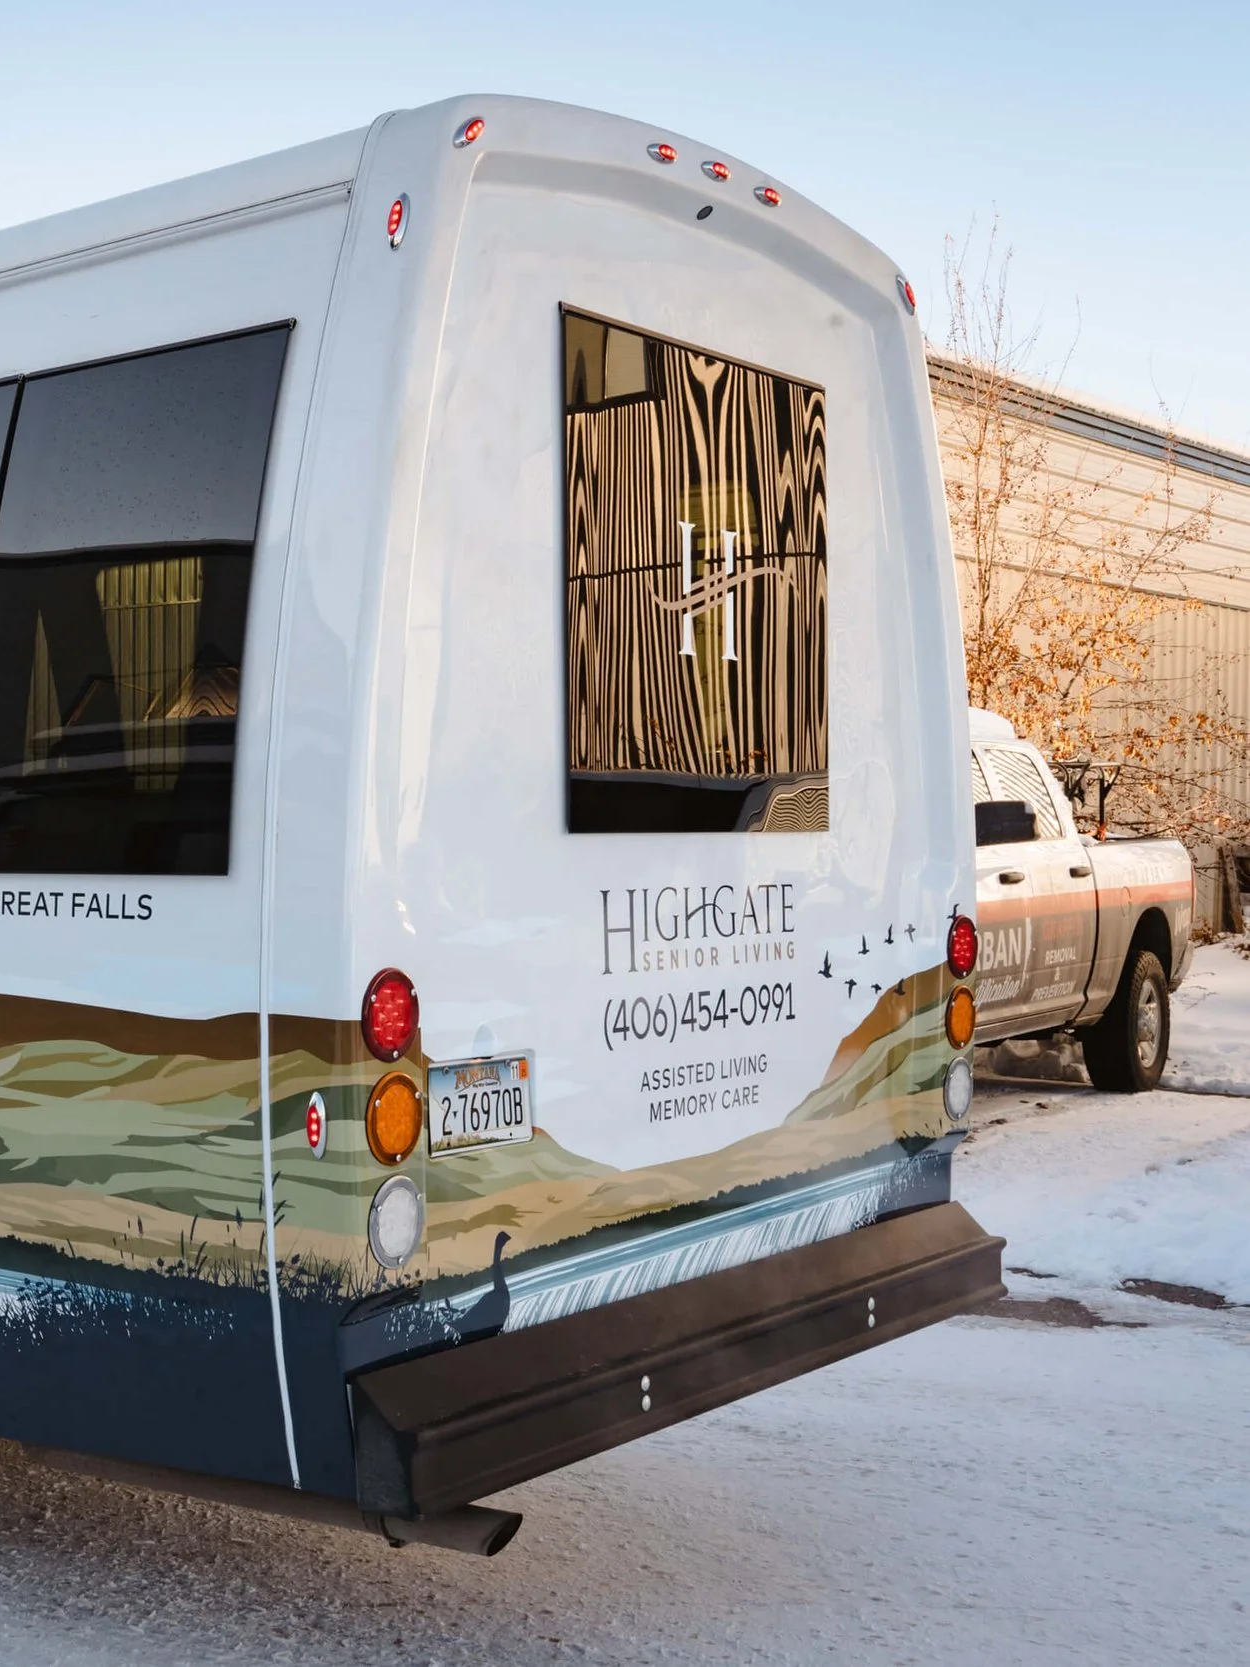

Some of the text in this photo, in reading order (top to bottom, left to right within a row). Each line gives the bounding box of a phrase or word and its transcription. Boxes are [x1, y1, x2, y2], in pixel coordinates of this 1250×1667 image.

[71, 892, 153, 920] FALLS
[600, 884, 795, 975] HIGHGATE
[642, 941, 795, 972] SENIOR LIVING
[1044, 945, 1077, 967] REMOVAL
[604, 982, 796, 1051] (406)454-0991
[640, 1053, 768, 1093] ASSISTED LIVING
[649, 1085, 759, 1123] MEMORY CARE
